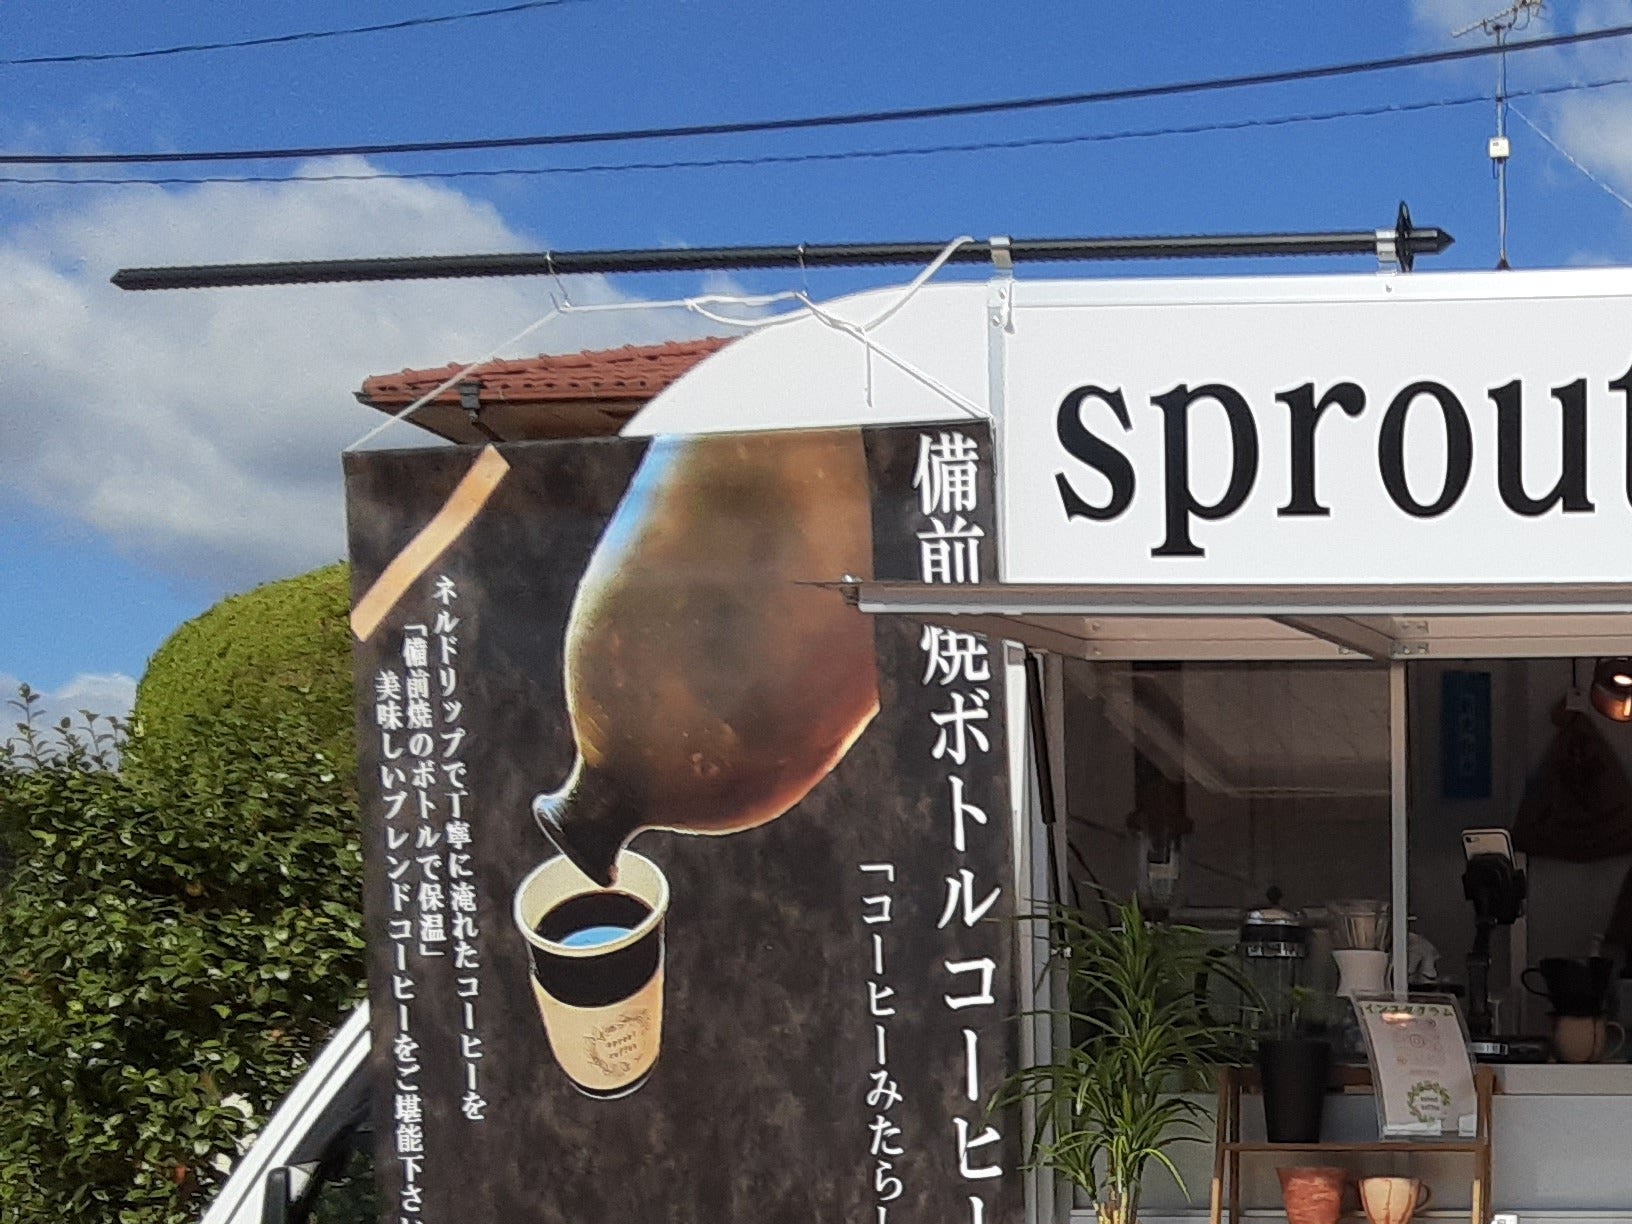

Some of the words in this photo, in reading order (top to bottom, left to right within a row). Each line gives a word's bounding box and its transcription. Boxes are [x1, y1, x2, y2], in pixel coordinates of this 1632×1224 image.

[432, 575, 488, 1120] ネルドリップで丁寧に淹れたコーヒーを
